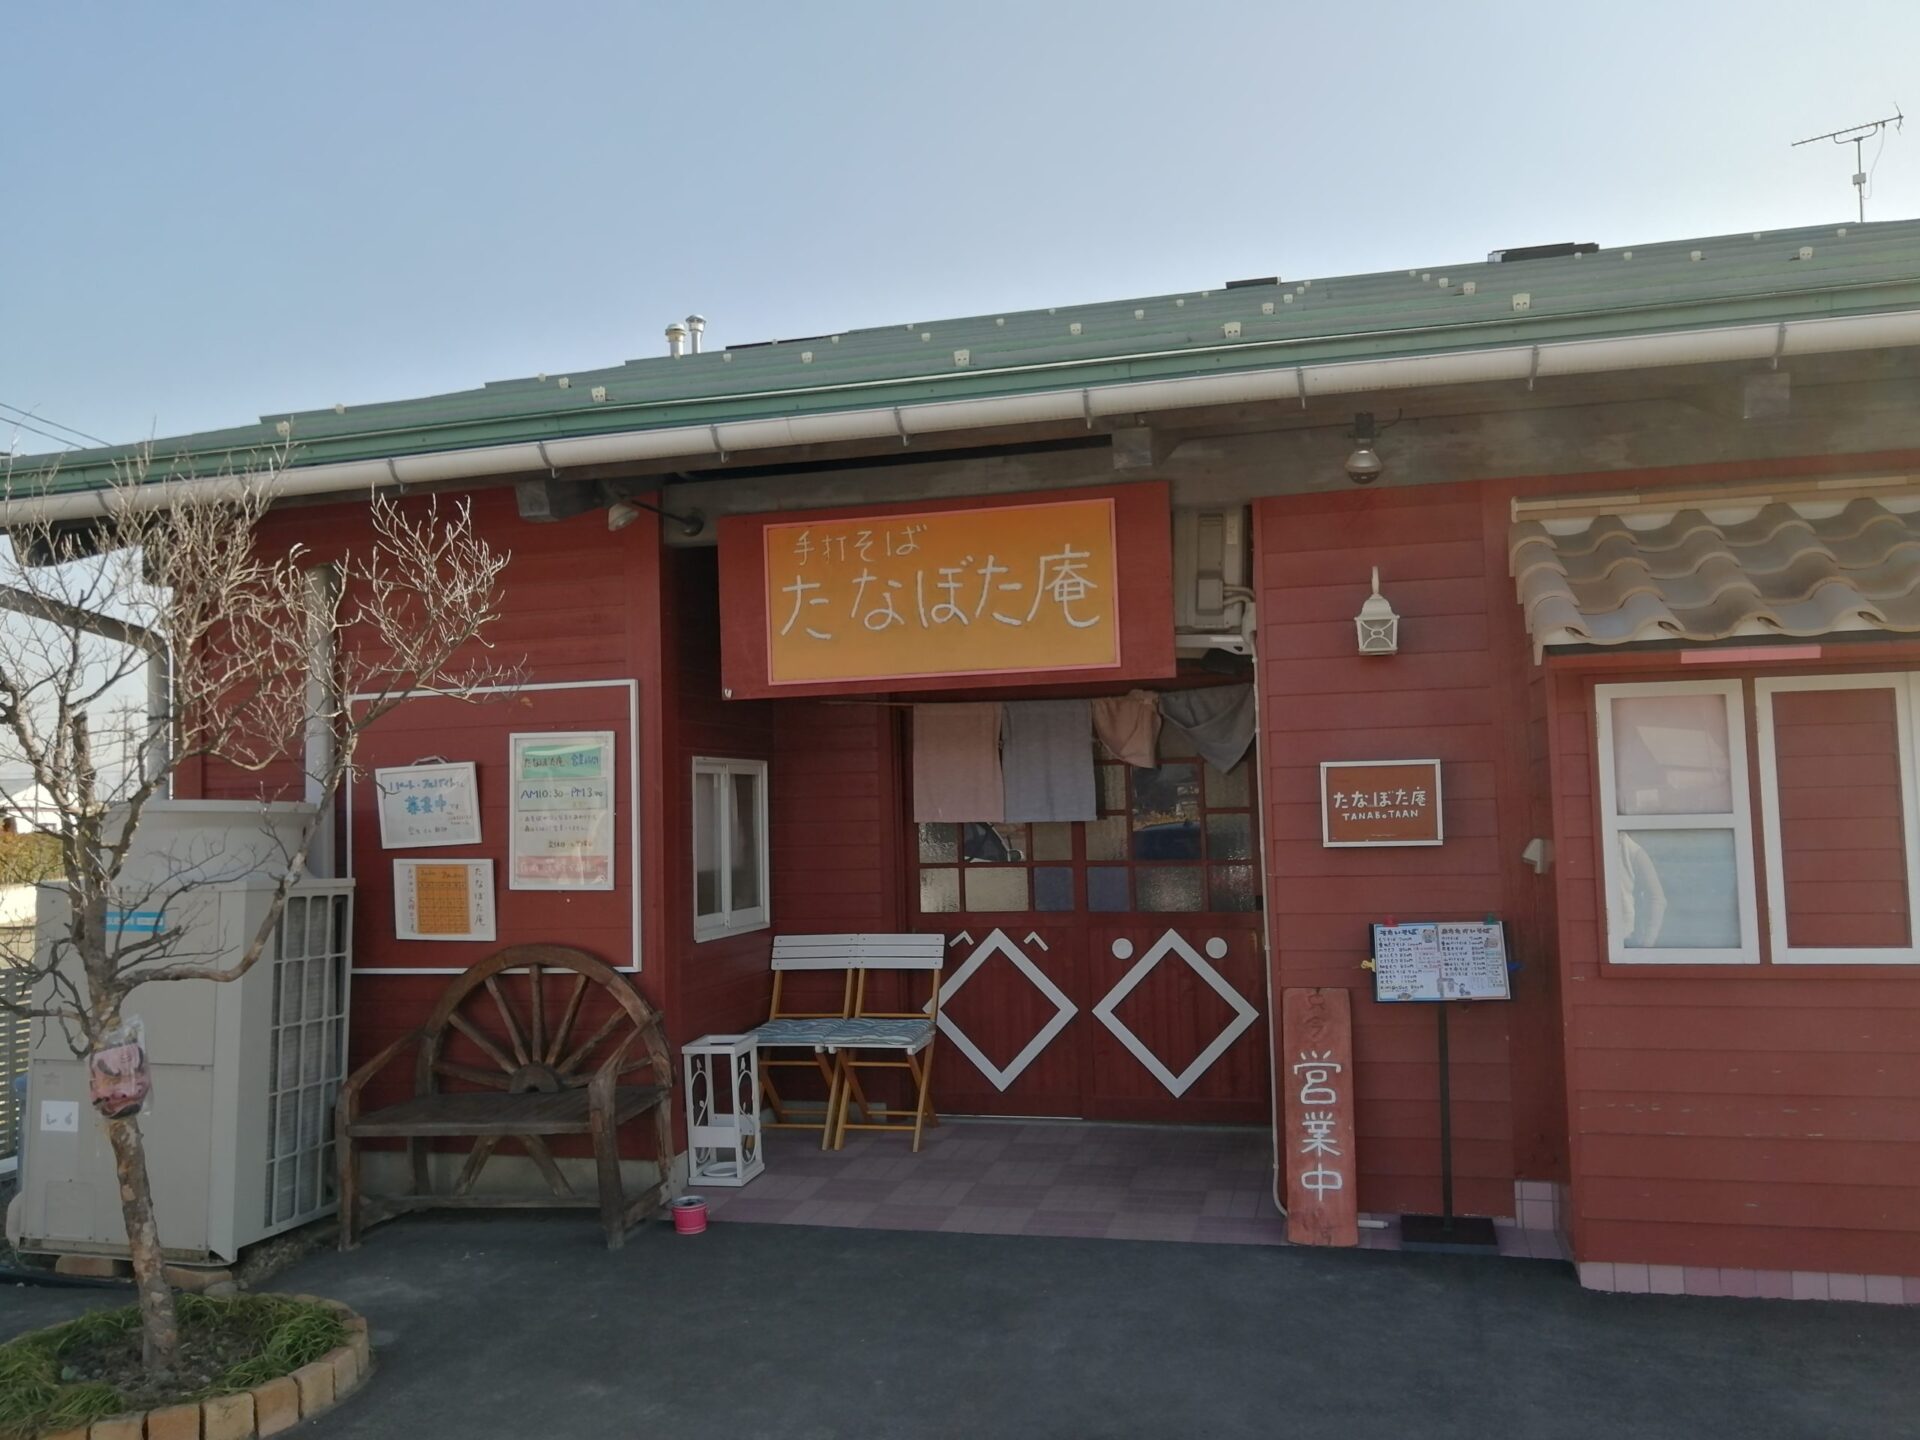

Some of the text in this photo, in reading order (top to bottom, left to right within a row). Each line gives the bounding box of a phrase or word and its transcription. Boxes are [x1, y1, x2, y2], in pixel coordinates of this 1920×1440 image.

[794, 524, 927, 565] 手打そば
[781, 543, 1100, 640] たなぼた庵
[1333, 786, 1427, 809] たなぼた庵
[1293, 1050, 1344, 1203] 営業中
